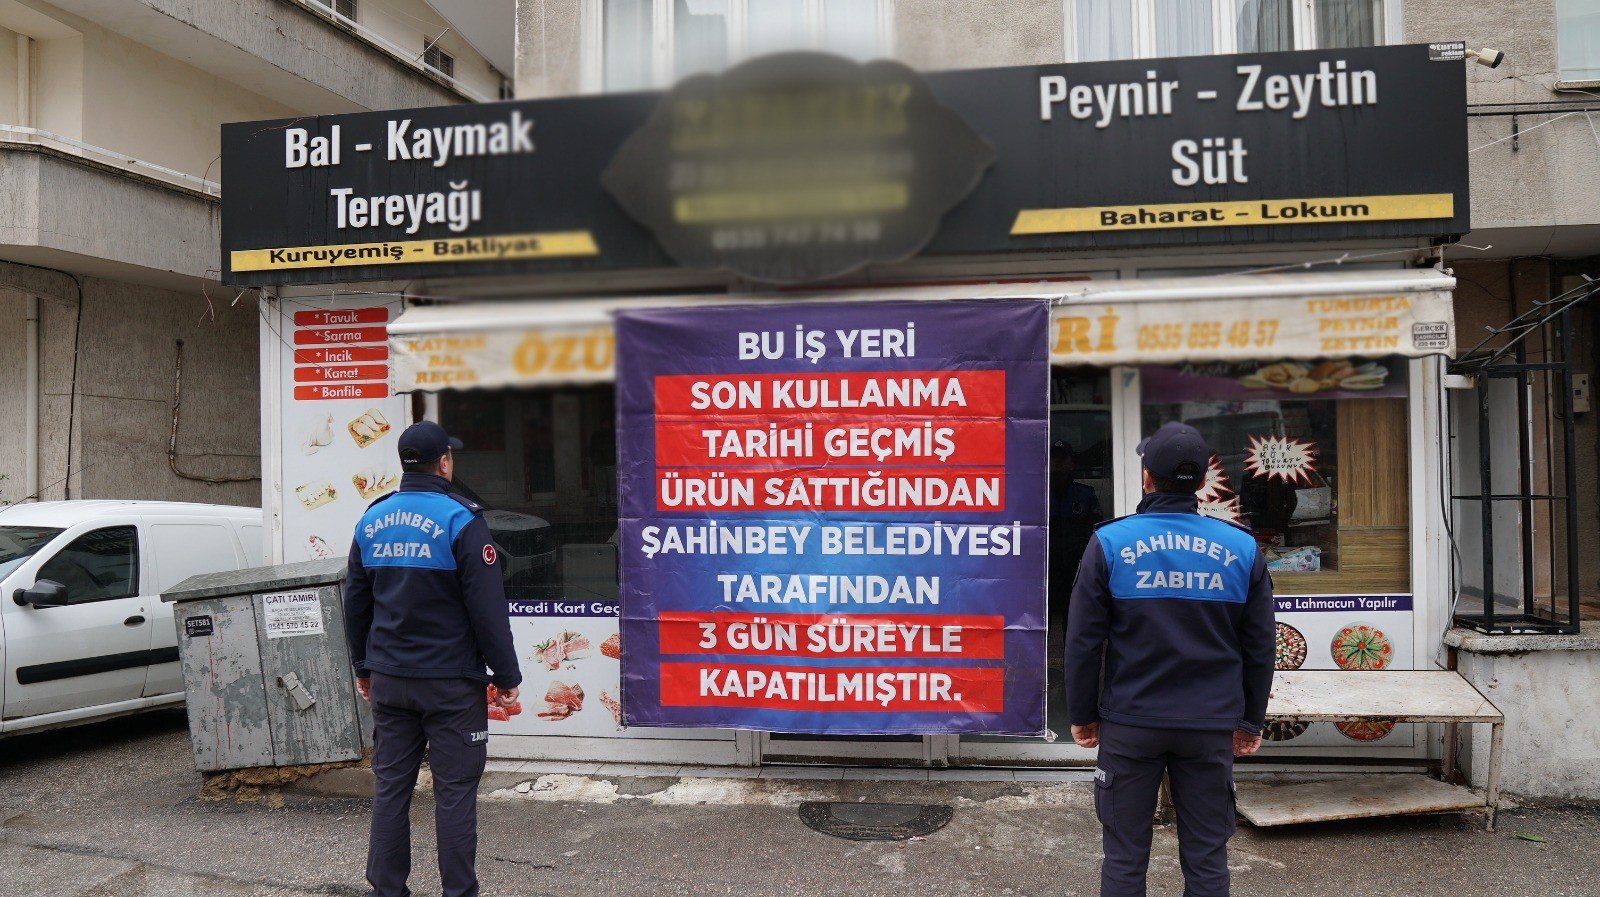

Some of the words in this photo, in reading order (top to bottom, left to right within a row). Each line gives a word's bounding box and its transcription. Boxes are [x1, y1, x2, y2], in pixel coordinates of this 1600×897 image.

[1040, 70, 1179, 127] Peynir
[1236, 60, 1378, 119] Zeytin
[285, 124, 341, 169] Bal
[387, 110, 535, 168] Kaymak
[1171, 137, 1248, 186] Süt
[331, 180, 482, 234] Tereyağı
[1100, 206, 1225, 226] Baharat
[1261, 202, 1369, 219] Lokum
[270, 243, 404, 264] Kuruyemiş
[433, 238, 540, 257] Bakliyat
[324, 312, 358, 324] Tavuk
[324, 330, 362, 342] Sarma
[738, 331, 785, 360] BU
[795, 324, 826, 365] İŞ
[836, 322, 915, 358] YERİ
[325, 349, 353, 362] İncik
[324, 367, 359, 379] Kanat
[322, 385, 363, 398] Bonfile
[690, 380, 762, 410] SON
[772, 377, 967, 408] KULLANMA
[702, 422, 814, 459] TARİHİ
[823, 422, 956, 463] GEÇMİŞ
[661, 472, 754, 507] ÜRÜN
[764, 470, 1000, 507] SATTIĞINDAN
[364, 508, 445, 540] ŞAHİNBEY
[640, 520, 812, 559] ŞAHİNBEY
[821, 520, 1022, 556] BELEDİYESİ
[372, 542, 432, 559] ZABITA
[1120, 531, 1239, 567] ŞAHİNBEY
[717, 574, 940, 605] TARAFINDAN
[1135, 570, 1225, 591] ZABITA
[265, 596, 286, 606] ÇATI
[287, 591, 317, 604] TAMİRİ
[508, 602, 548, 614] Kredi
[554, 602, 585, 614] Kart
[1278, 601, 1292, 609] ve
[1295, 598, 1355, 610] Lahmacun
[1358, 597, 1397, 611] Yapılır
[698, 622, 718, 649] 3
[727, 617, 798, 652] GÜN
[806, 618, 963, 653] SÜREYLE
[699, 668, 963, 707] KAPATILMIŞTIR.
